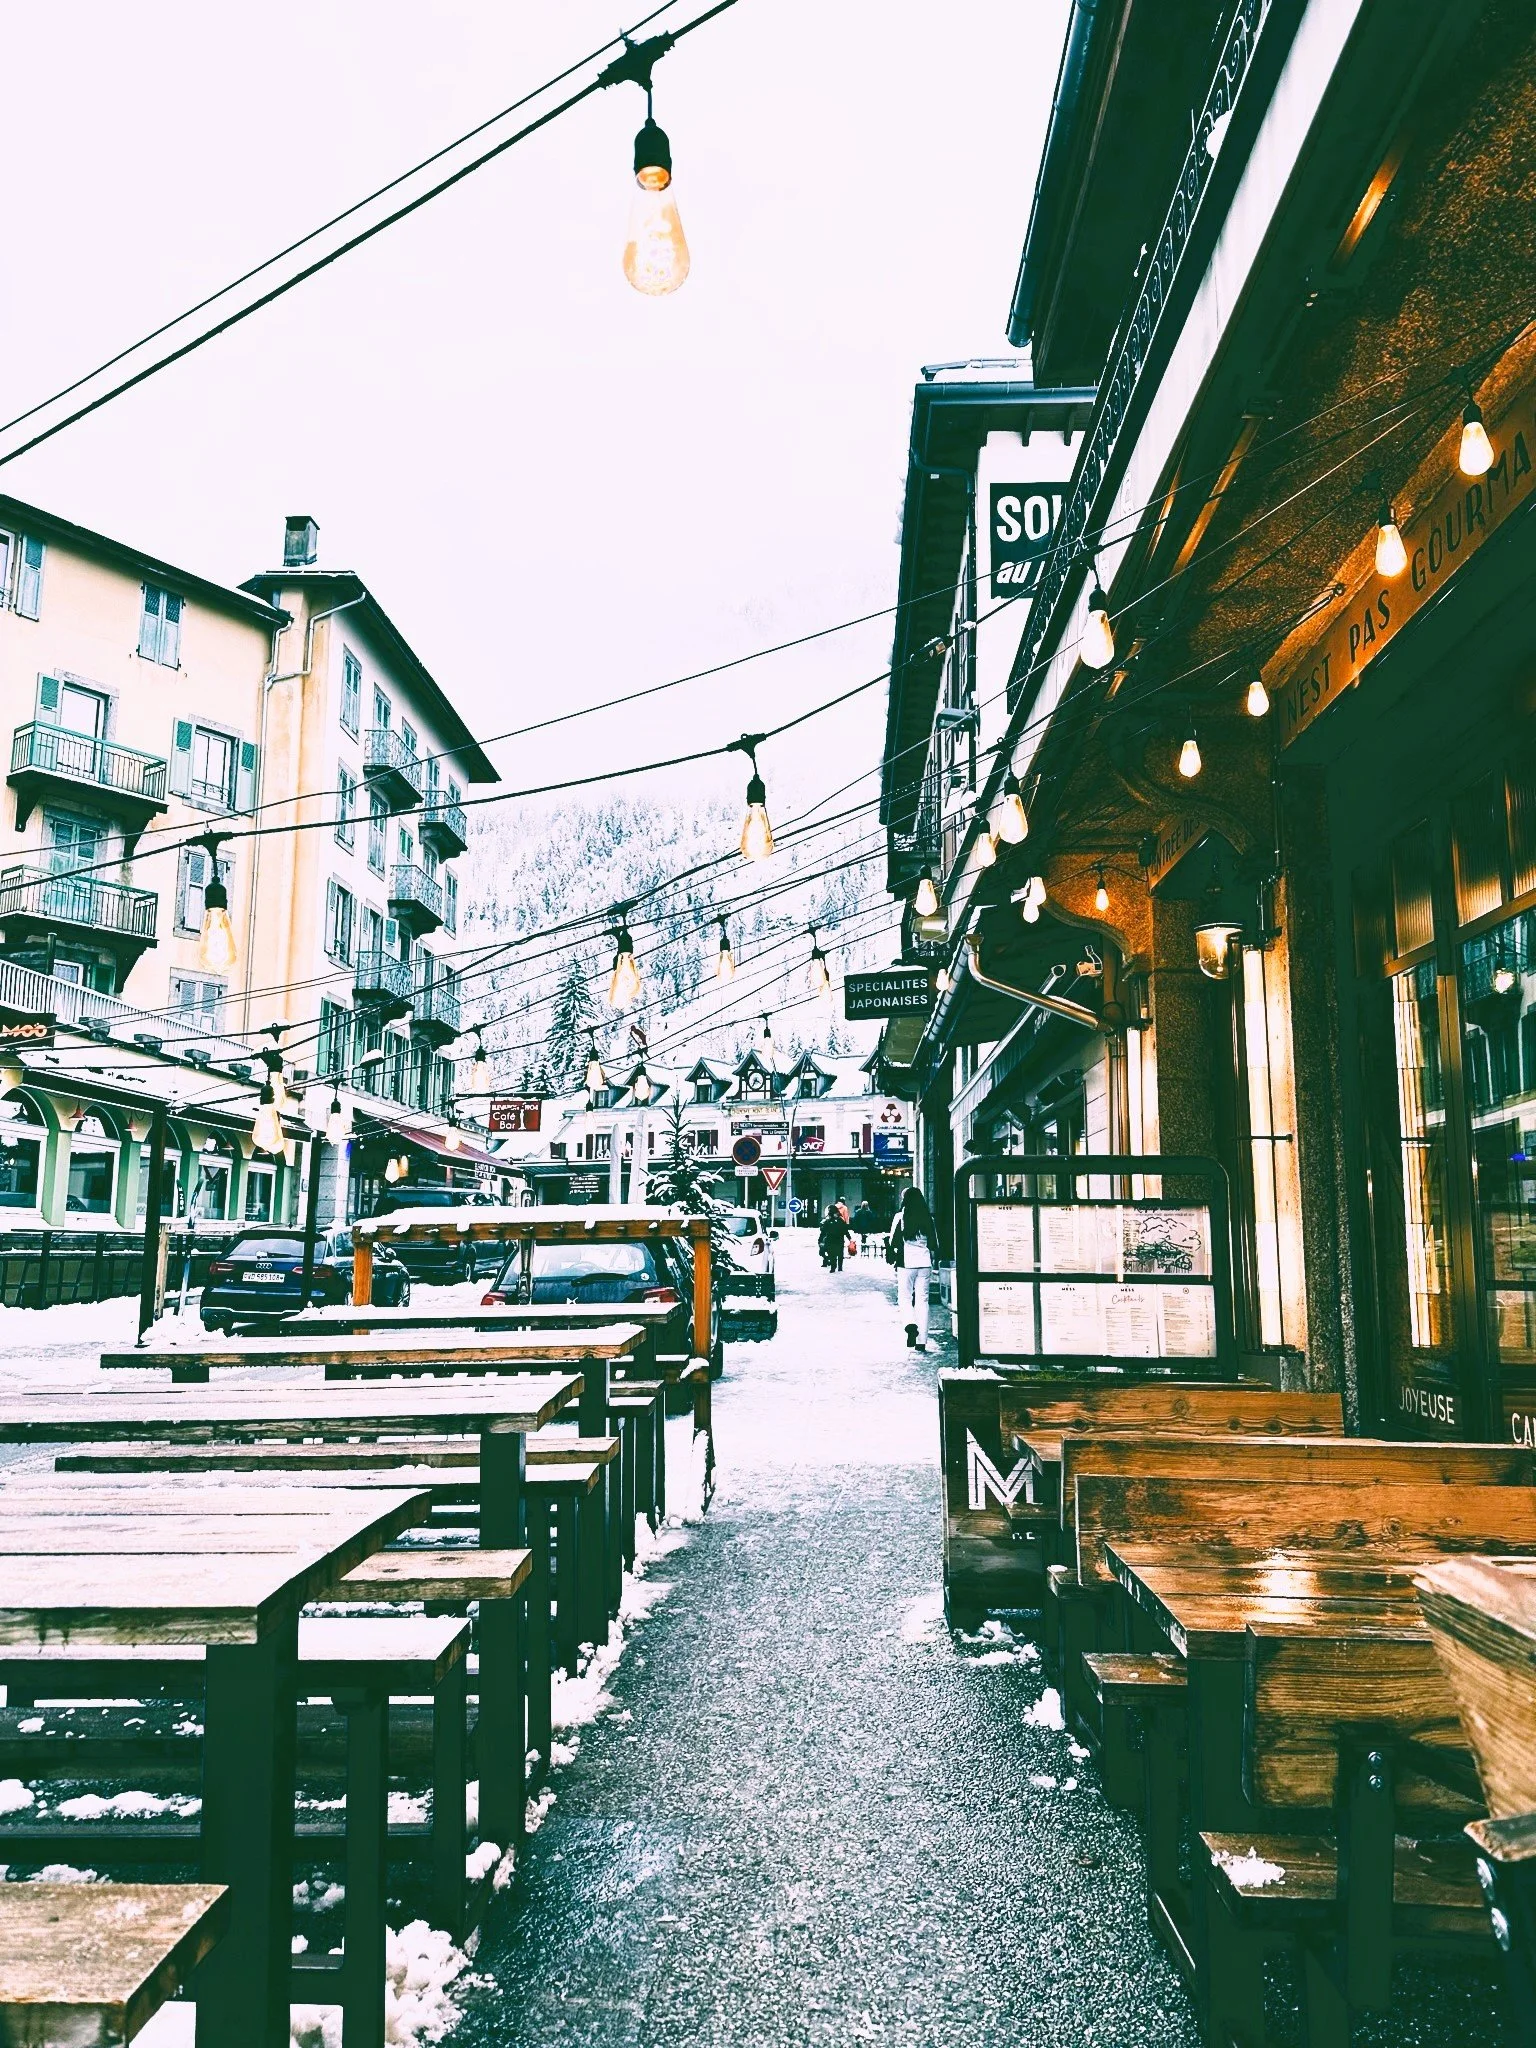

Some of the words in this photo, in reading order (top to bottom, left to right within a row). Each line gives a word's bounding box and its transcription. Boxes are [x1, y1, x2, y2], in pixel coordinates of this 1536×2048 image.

[996, 561, 1033, 584] au
[1349, 589, 1391, 664] PAS
[848, 978, 928, 993] SPECIALITES
[849, 994, 928, 1009] JAPONAISES
[492, 1112, 516, 1121] Café
[500, 1121, 515, 1130] Bar
[1399, 1385, 1455, 1425] JOYEUSE
